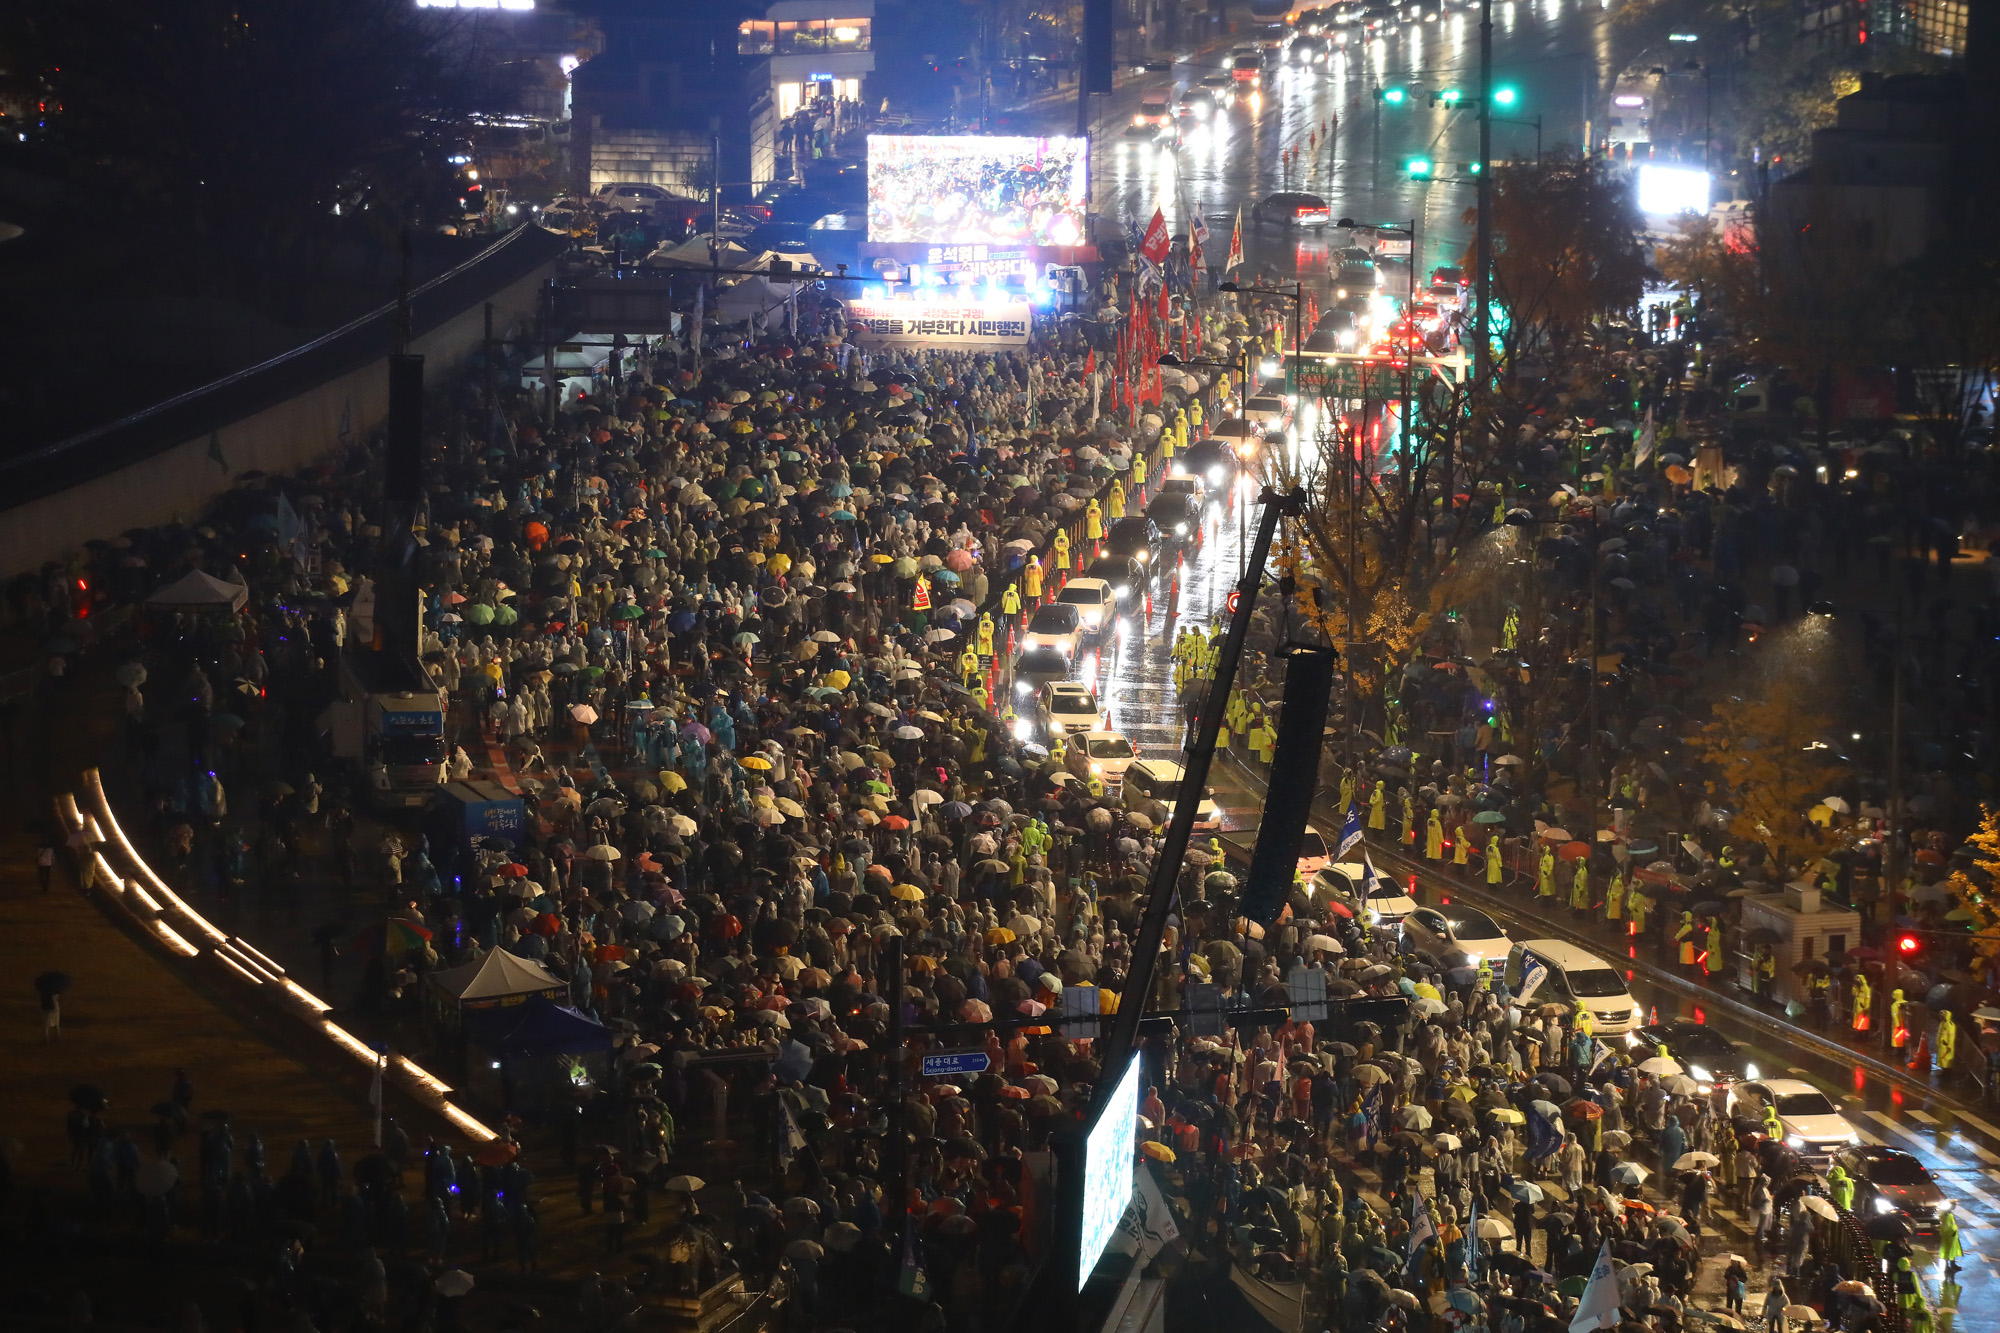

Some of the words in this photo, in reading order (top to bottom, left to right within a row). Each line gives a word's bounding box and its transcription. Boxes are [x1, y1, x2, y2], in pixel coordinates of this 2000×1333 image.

[962, 309, 984, 319] 규명!
[908, 320, 965, 335] 거부한다
[968, 321, 1025, 336] 시민행진
[925, 1057, 960, 1066] 세종대로
[925, 1066, 963, 1074] Sejong-daero
